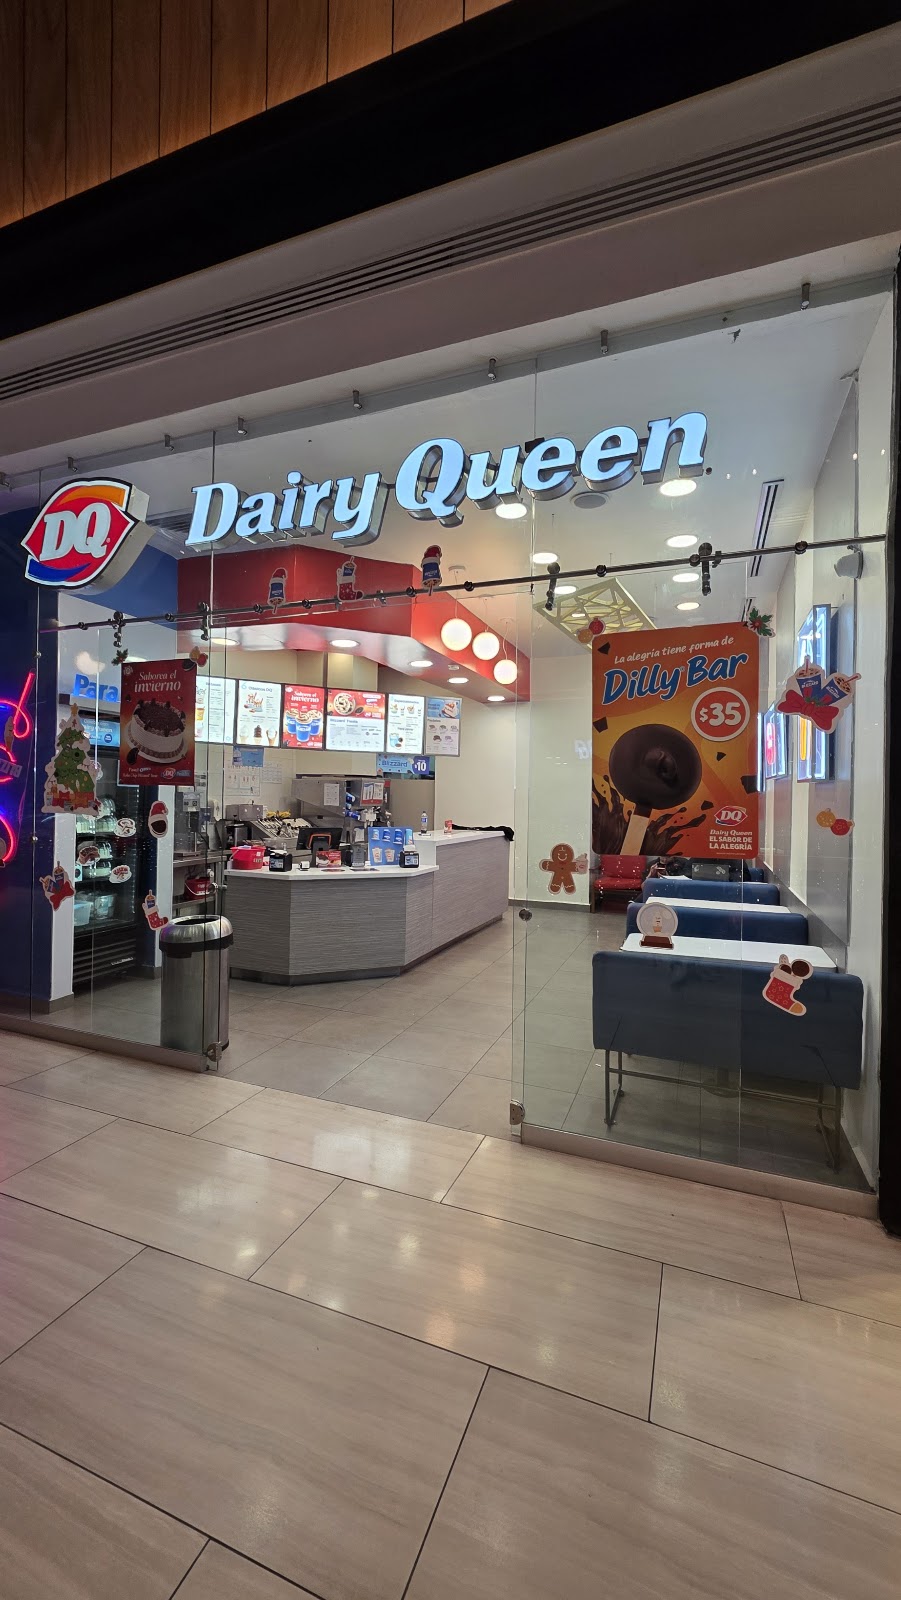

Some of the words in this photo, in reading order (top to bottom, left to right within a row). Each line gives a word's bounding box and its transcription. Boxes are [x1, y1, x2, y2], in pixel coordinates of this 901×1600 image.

[184, 470, 384, 547] Dairy
[394, 410, 709, 519] Queen
[39, 502, 112, 561] DQ
[614, 655, 625, 664] La
[626, 649, 660, 662] alegría
[662, 645, 687, 657] tiene
[688, 640, 720, 653] forma
[720, 636, 735, 646] de
[73, 673, 120, 702] Para
[134, 680, 182, 693] invierno
[138, 671, 169, 681] Saborea
[169, 669, 177, 680] el
[602, 663, 681, 705] Dilly
[686, 653, 749, 688] Bar
[699, 702, 742, 727] $35
[381, 759, 408, 768] Blizzard
[720, 810, 743, 822] DQ
[709, 829, 729, 837] Dairy
